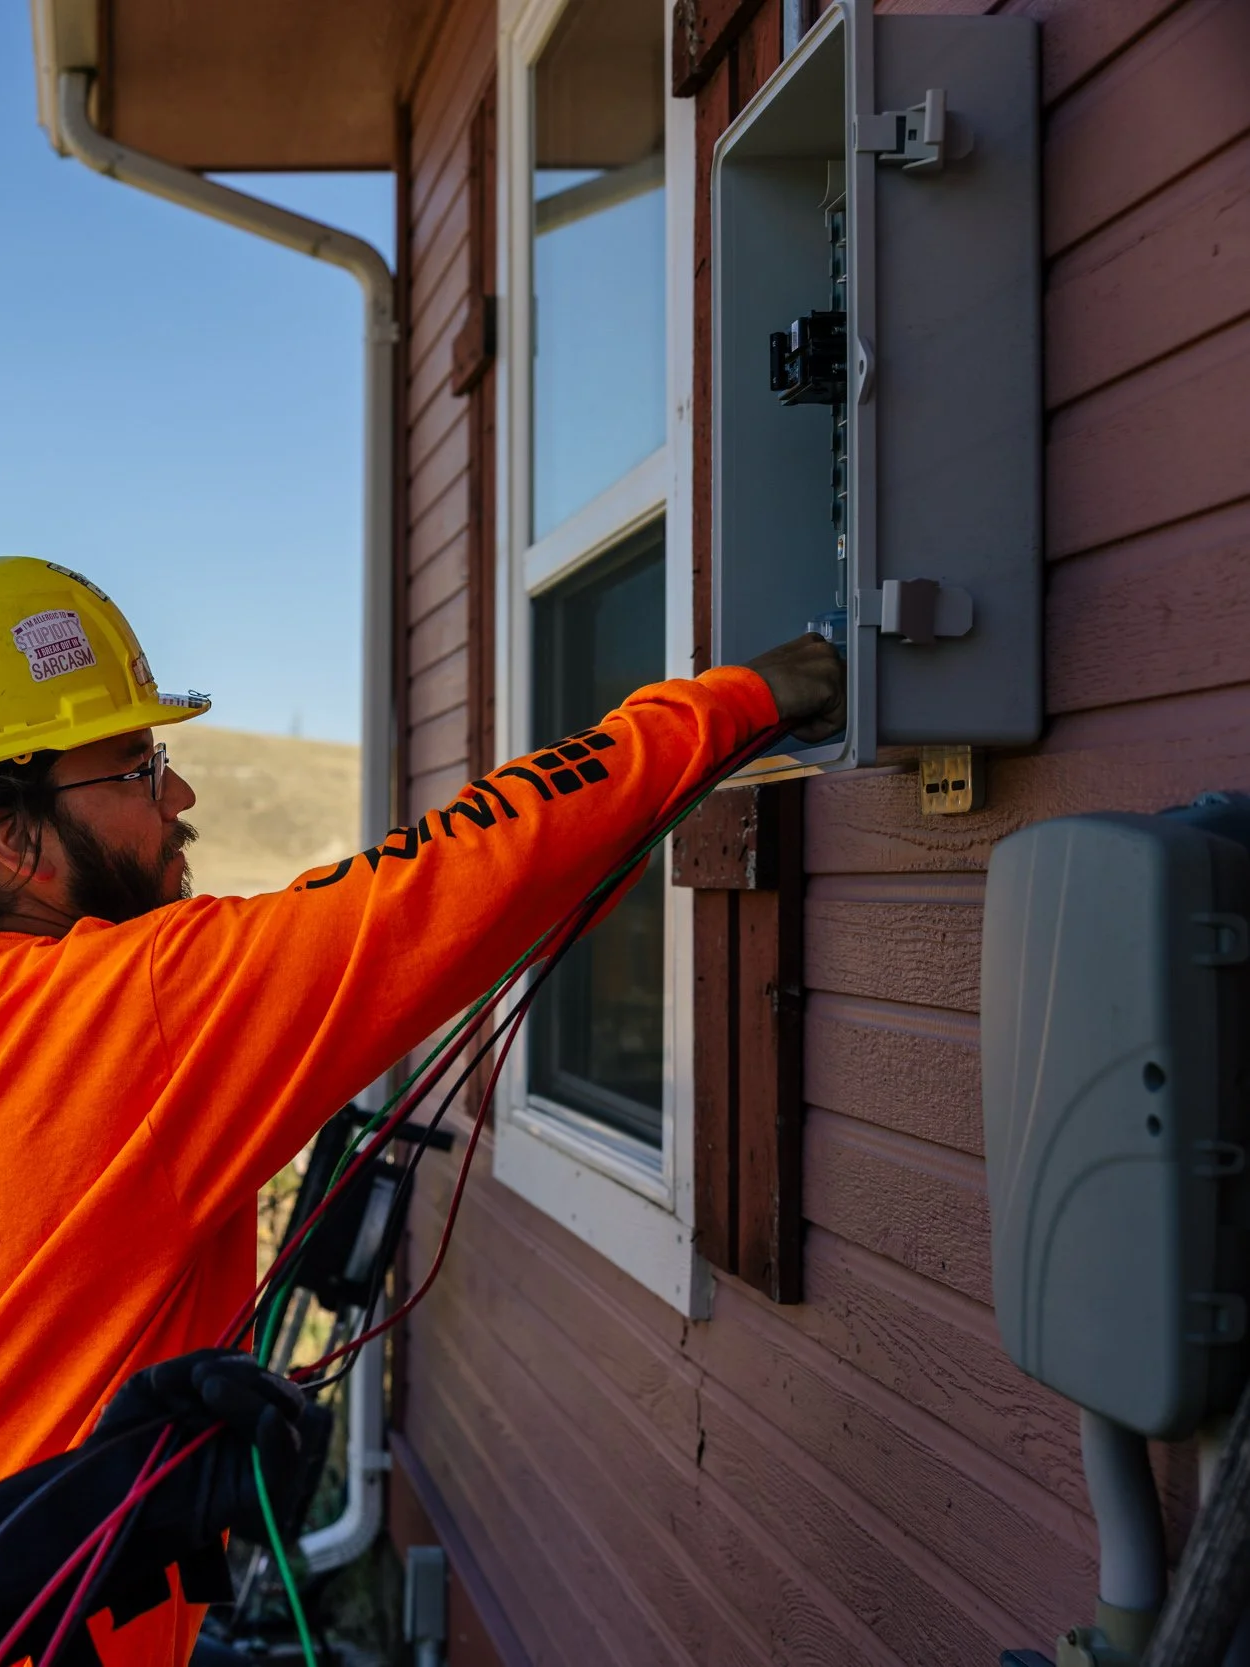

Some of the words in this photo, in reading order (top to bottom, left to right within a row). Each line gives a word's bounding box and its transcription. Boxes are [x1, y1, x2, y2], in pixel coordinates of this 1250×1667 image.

[22, 620, 34, 630] I'M
[33, 612, 59, 625] ALLERGIC
[59, 611, 67, 619] TO
[16, 618, 82, 651] STUPIDITY
[41, 645, 61, 656] BREAK
[60, 641, 72, 650] OUT
[71, 639, 80, 648] IN
[31, 647, 95, 680] SARCASM
